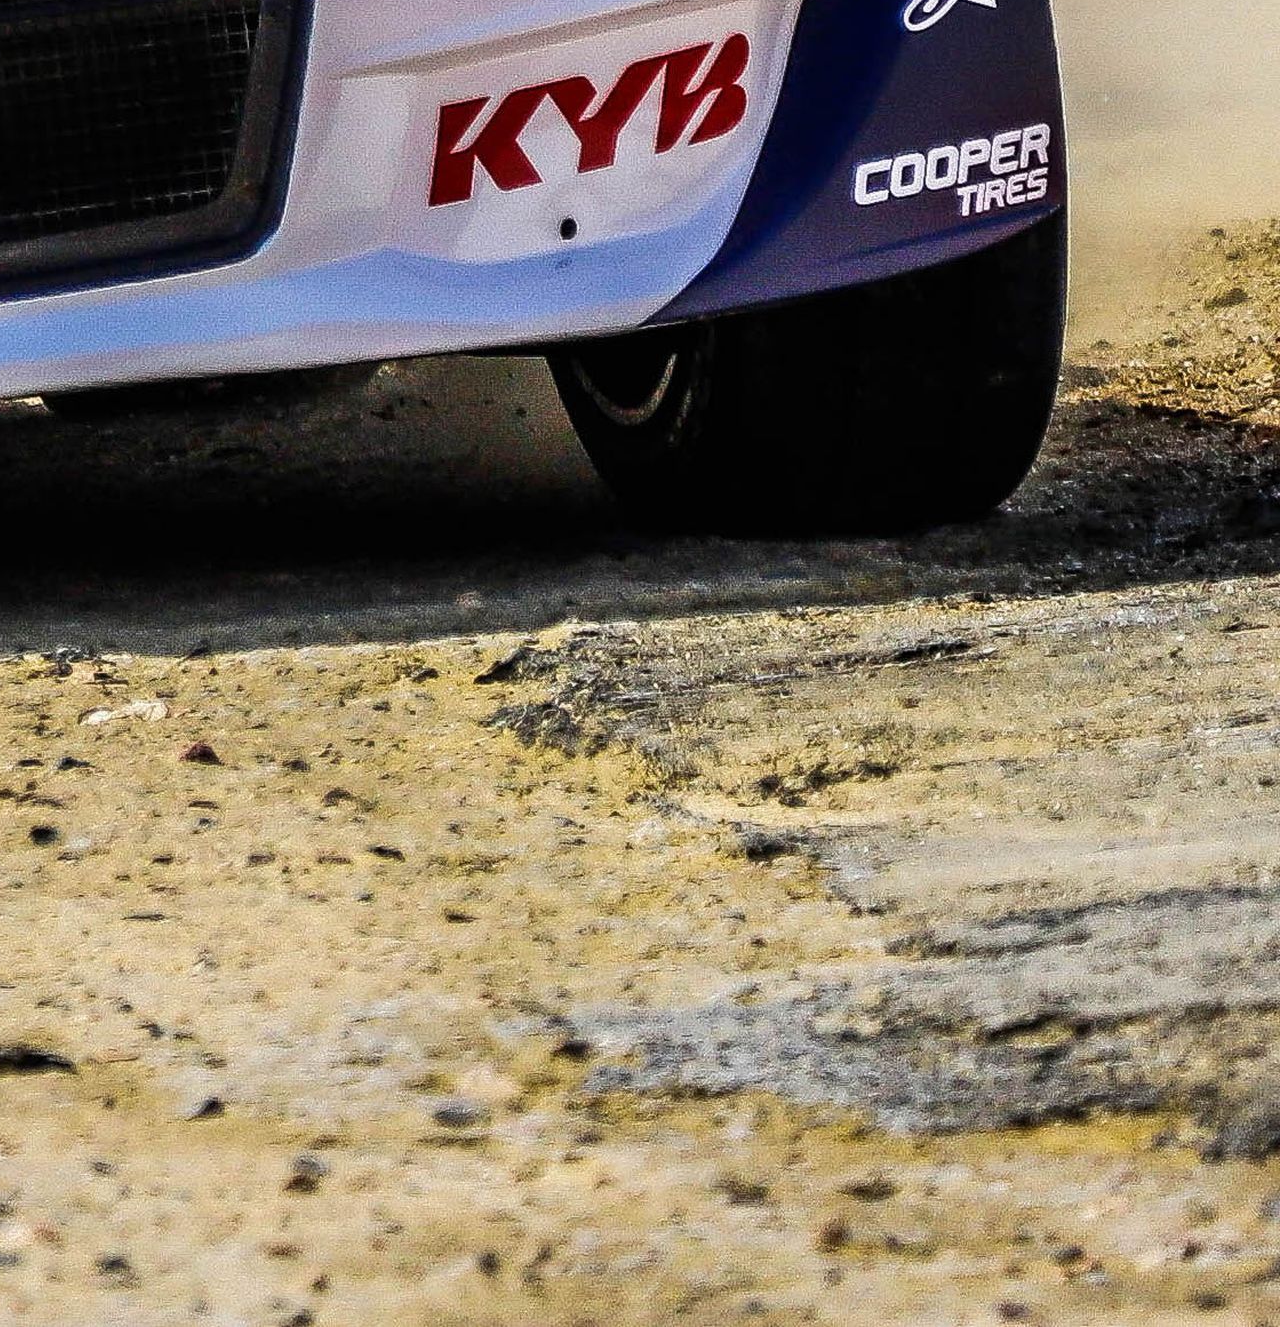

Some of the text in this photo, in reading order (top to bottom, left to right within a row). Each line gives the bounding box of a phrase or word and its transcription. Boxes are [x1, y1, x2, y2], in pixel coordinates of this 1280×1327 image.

[427, 32, 751, 207] KYB
[853, 122, 1051, 207] COOPER
[956, 166, 1049, 217] TIRES
